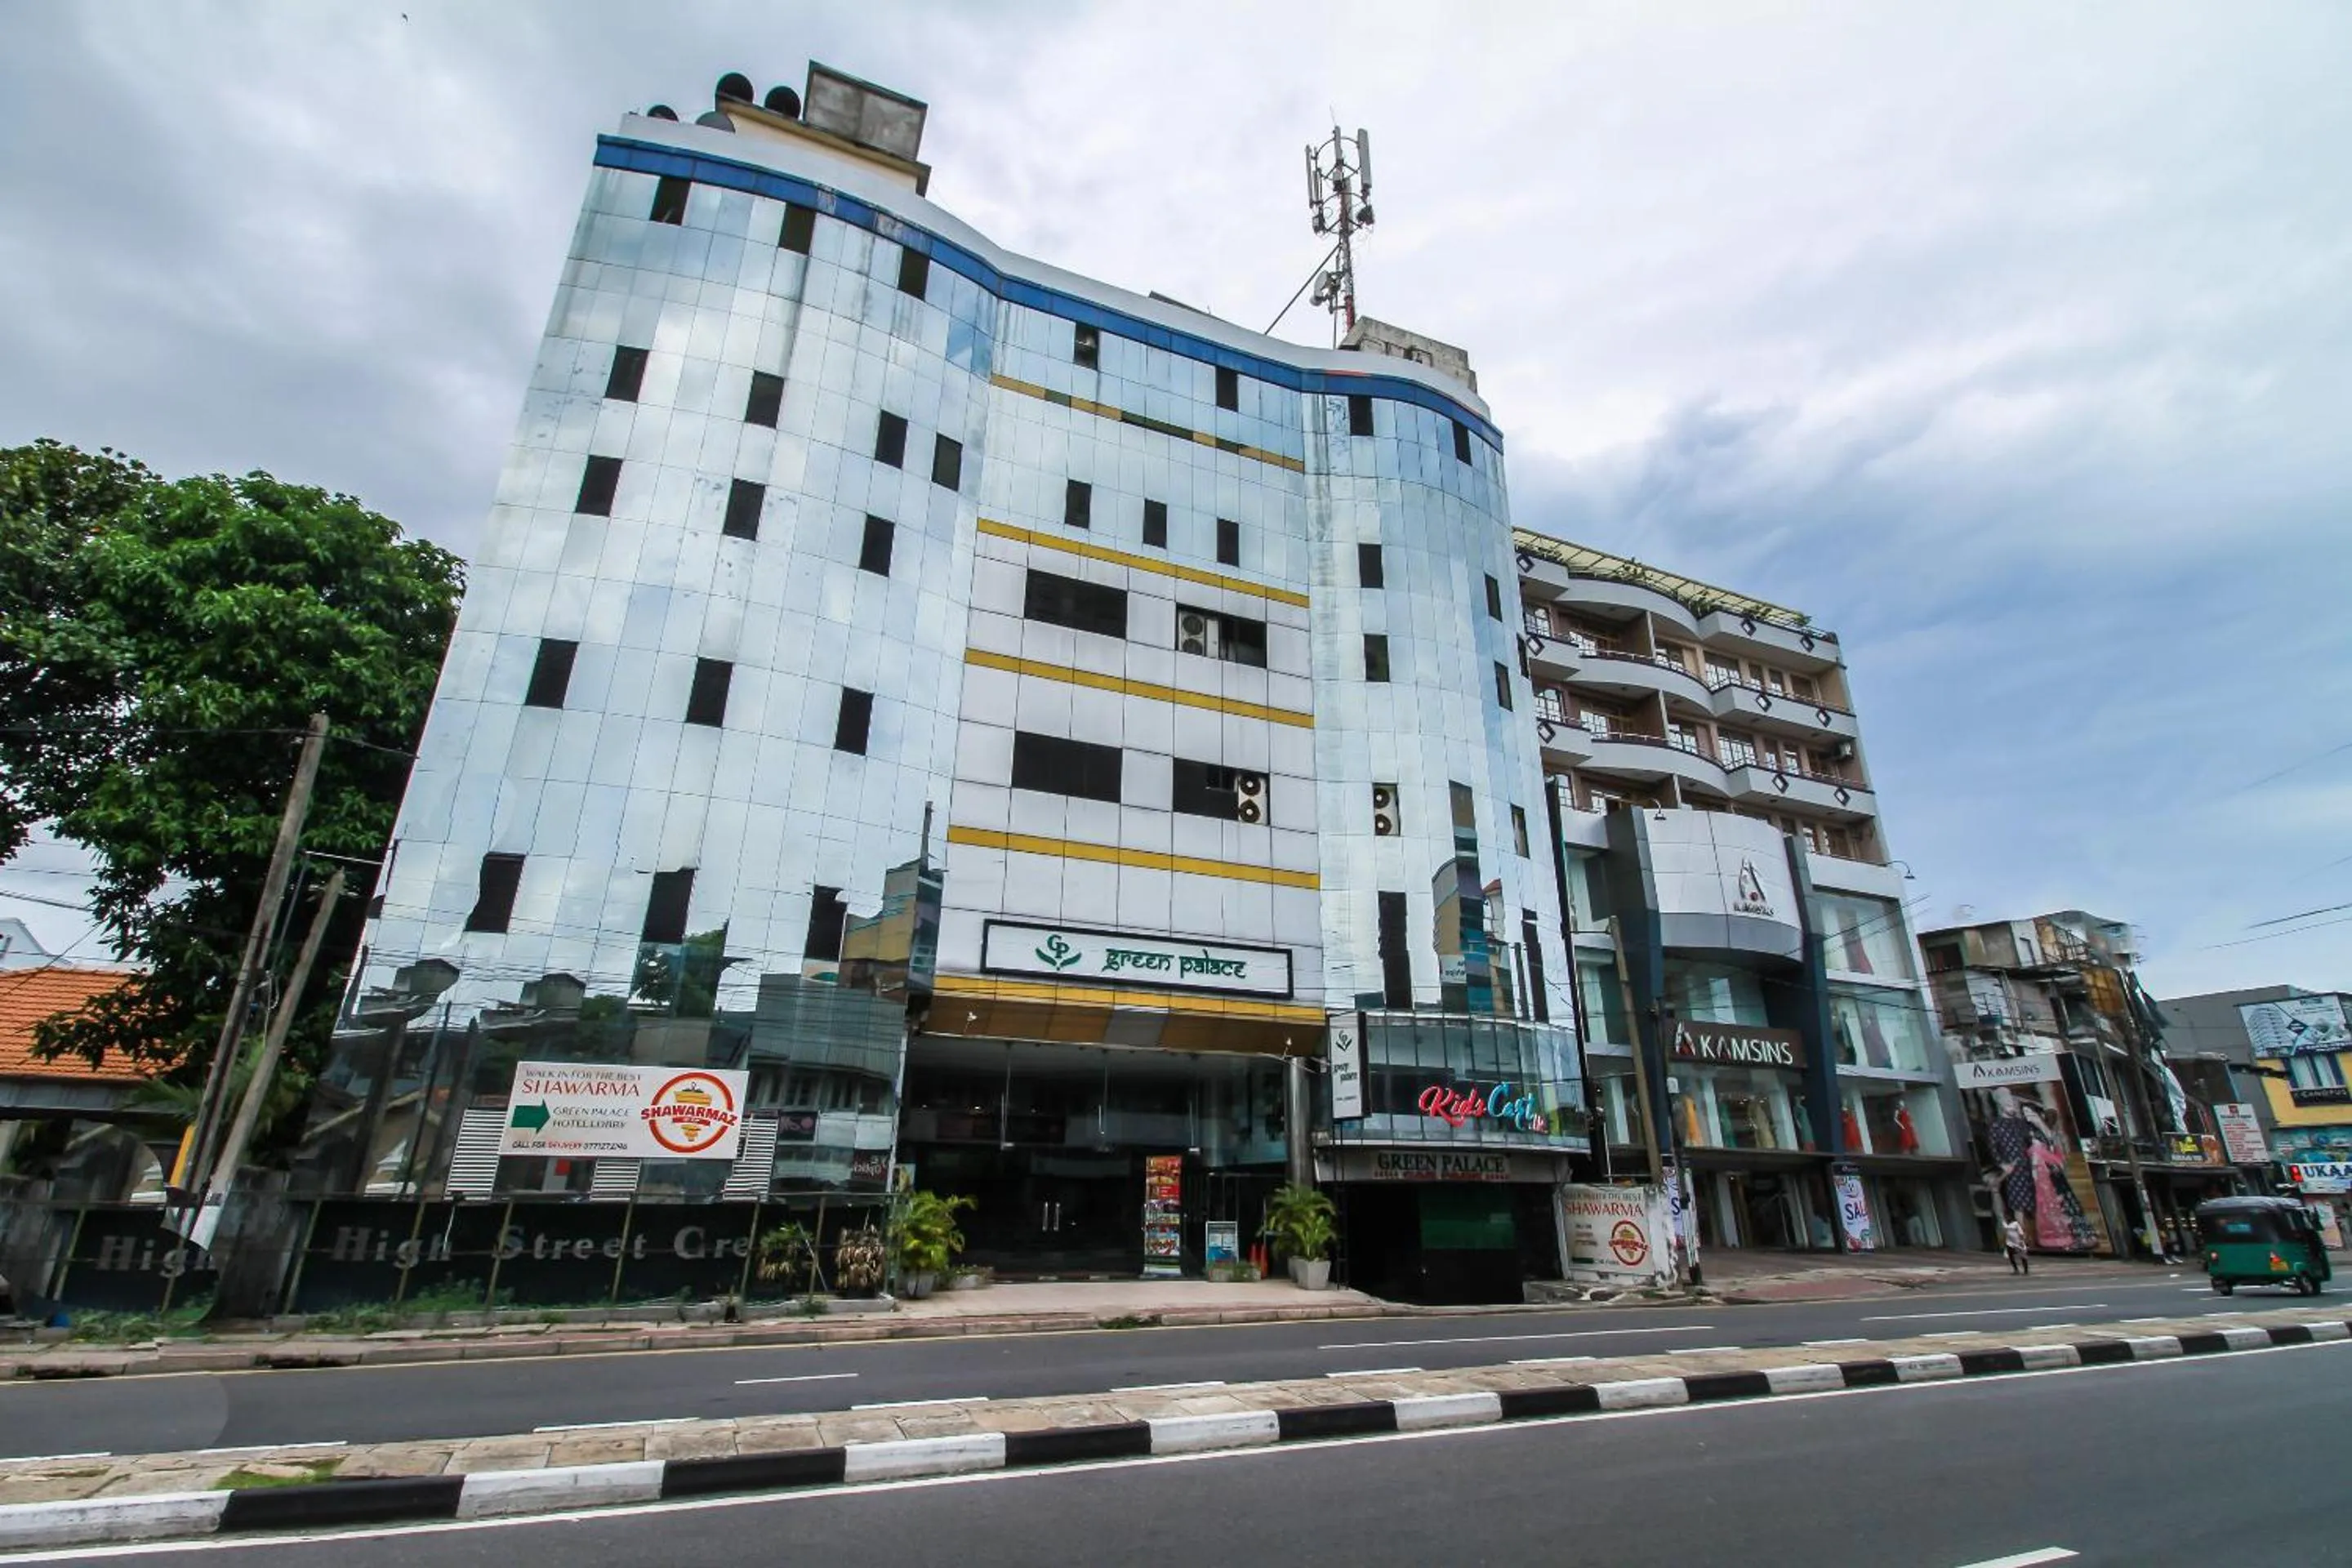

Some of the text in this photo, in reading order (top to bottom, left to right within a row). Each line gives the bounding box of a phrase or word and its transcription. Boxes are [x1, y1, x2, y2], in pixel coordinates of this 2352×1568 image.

[1102, 948, 1246, 978] green palace
[1699, 1034, 1793, 1065] KAMSINS
[595, 1071, 614, 1080] THE
[617, 1072, 641, 1080] BEST
[522, 1078, 639, 1097] SHAWARMA
[553, 1106, 630, 1117] GREEN PALACE
[1419, 1081, 1486, 1128] Kids
[553, 1119, 590, 1129] HOTEL
[640, 1104, 737, 1126] SHAWARMAZ
[1378, 1152, 1505, 1172] GREEN PALACE
[1565, 1201, 1644, 1217] SHAWARMA
[331, 1227, 452, 1269] High
[492, 1224, 647, 1260] Street
